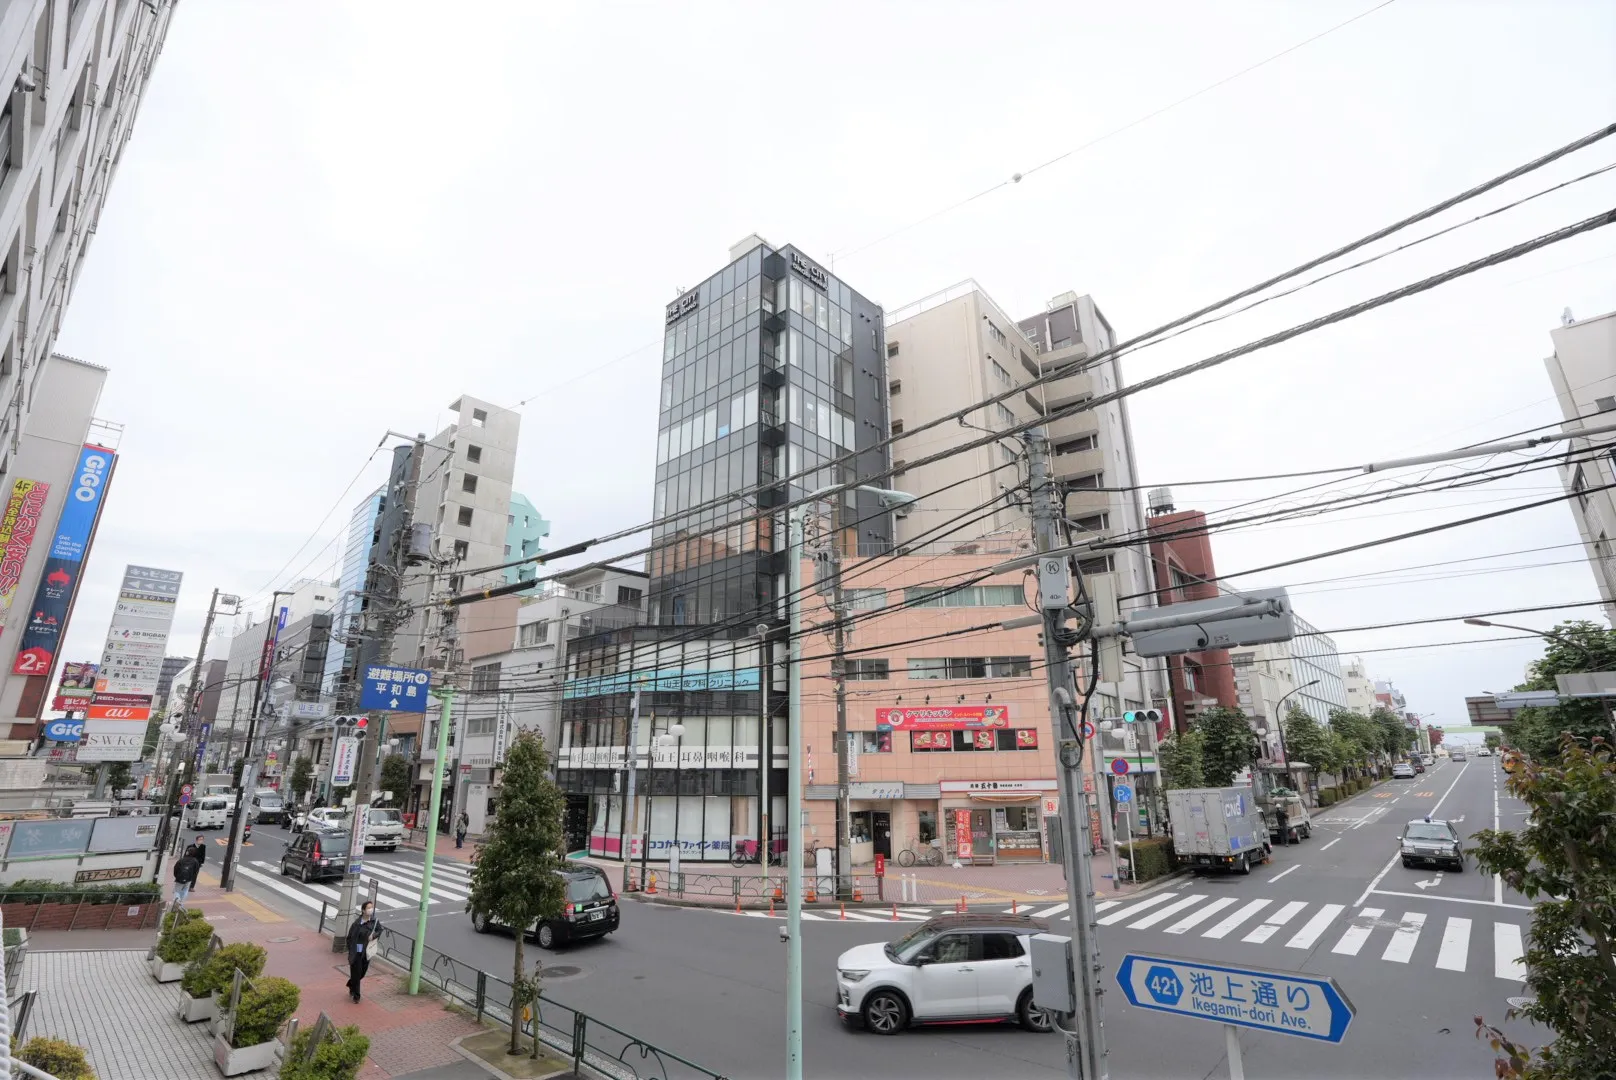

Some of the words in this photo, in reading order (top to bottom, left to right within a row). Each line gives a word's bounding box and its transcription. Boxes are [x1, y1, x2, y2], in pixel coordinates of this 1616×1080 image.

[810, 266, 828, 283] CITY
[666, 304, 679, 318] THE
[682, 292, 698, 308] CITY
[75, 455, 106, 502] GiGO
[15, 481, 31, 492] 4F
[54, 549, 72, 557] Oasis
[55, 545, 81, 553] Gaming
[19, 653, 47, 671] 2F
[367, 668, 416, 683] 避難場所
[375, 682, 417, 697] 平和島
[105, 707, 134, 718] au
[906, 710, 952, 719] クマリキッチン
[654, 751, 745, 763] 山王耳鼻咽喉科
[77, 867, 140, 882] 山王アーバンライフ
[1151, 973, 1179, 998] 421
[1190, 971, 1311, 1012] 池上通り
[1192, 997, 1276, 1024] Ikegami-dori
[1280, 1011, 1312, 1030] Ave.
